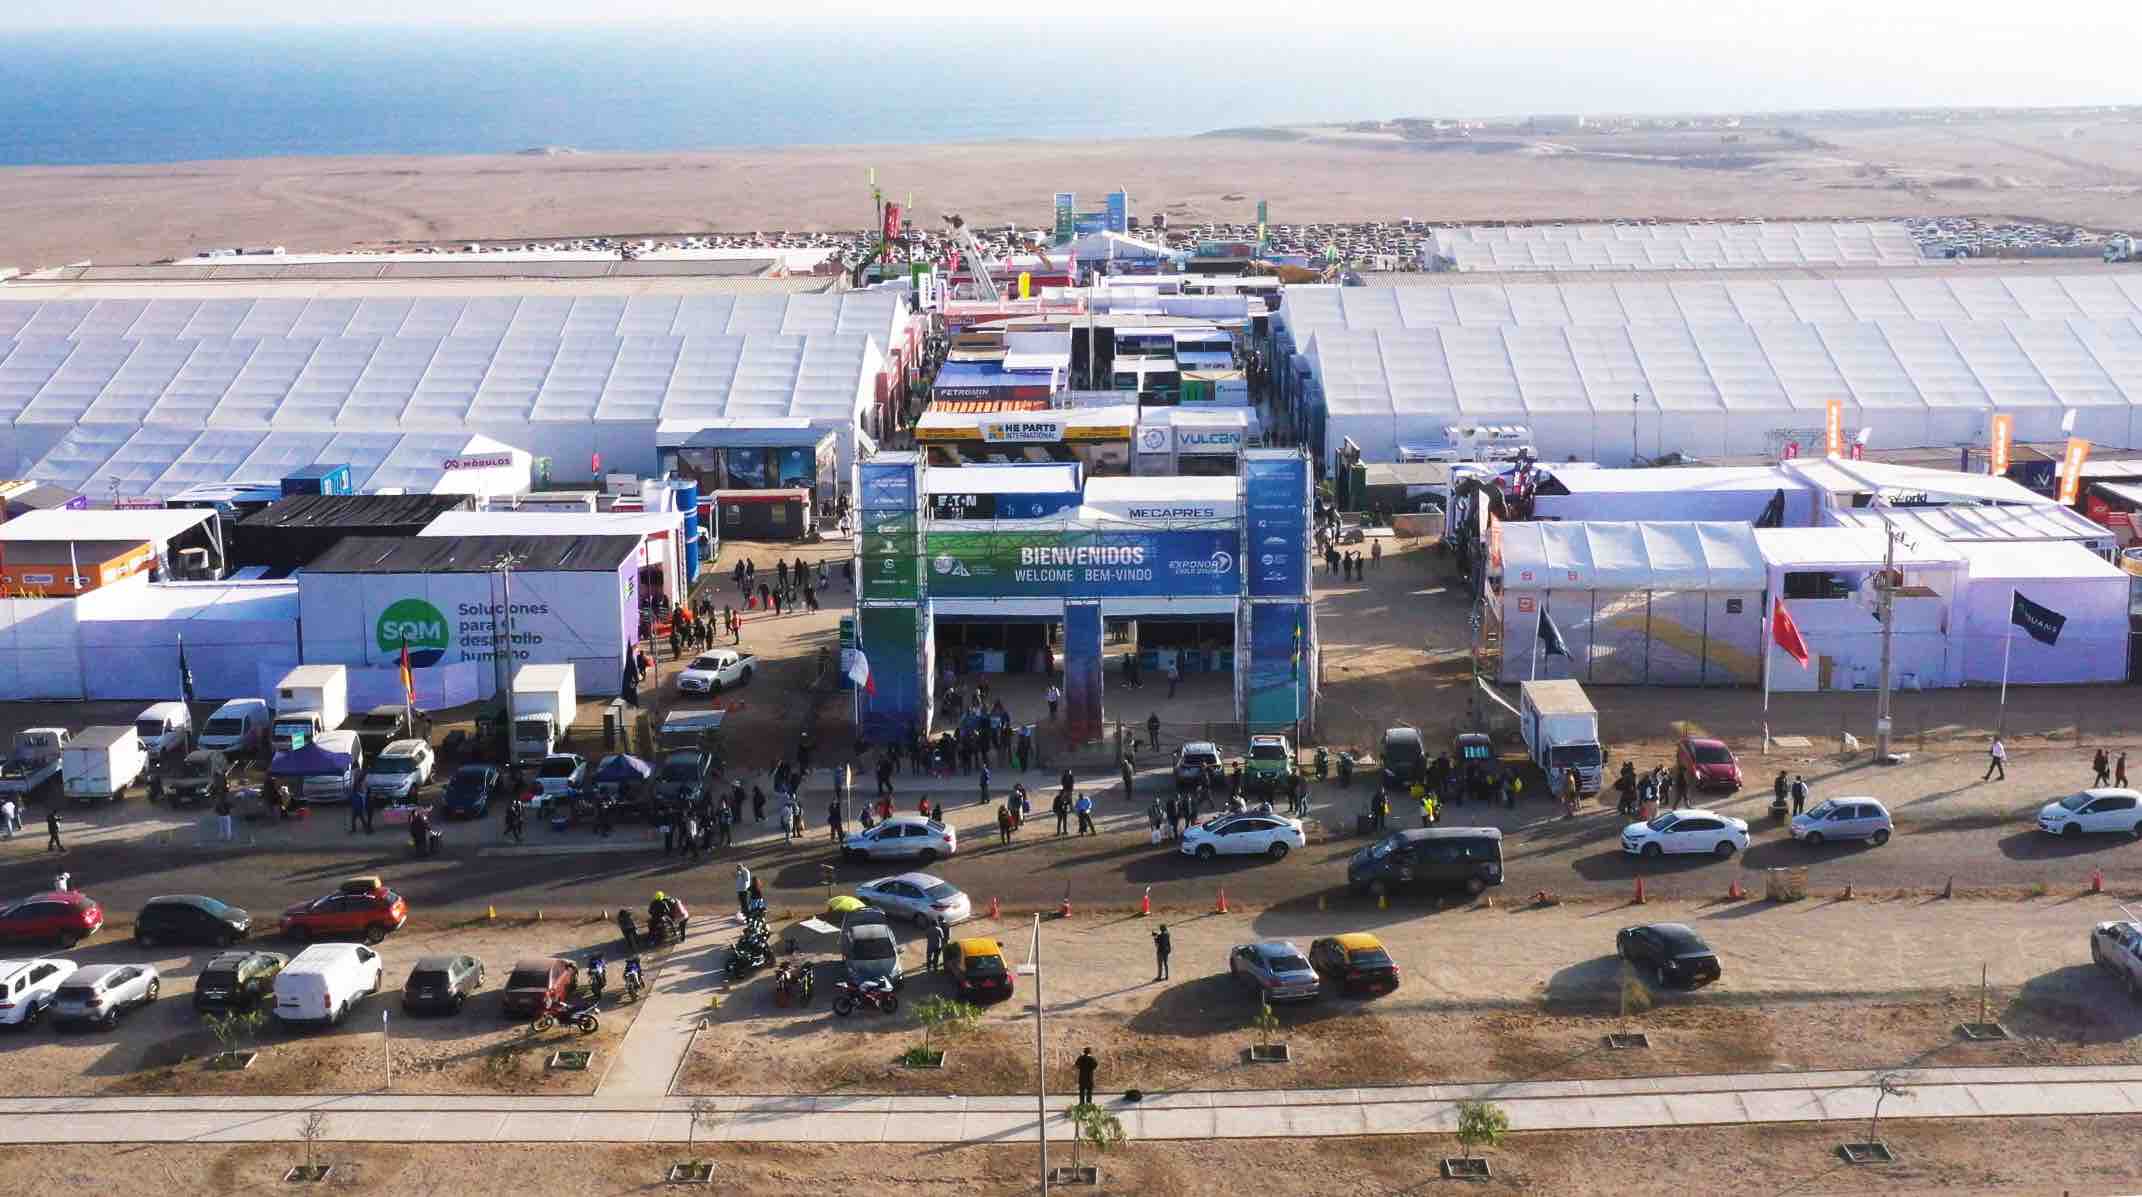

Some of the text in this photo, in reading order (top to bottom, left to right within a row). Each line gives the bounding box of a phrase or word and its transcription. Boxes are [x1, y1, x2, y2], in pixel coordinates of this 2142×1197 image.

[1024, 424, 1056, 432] PARTS
[1129, 508, 1214, 519] MECAPRES
[1021, 546, 1145, 566] BIENVENIDOS
[1015, 568, 1152, 582] WELCOME BEM-VINDO
[458, 602, 549, 616] Solucones
[383, 621, 441, 641] SQM
